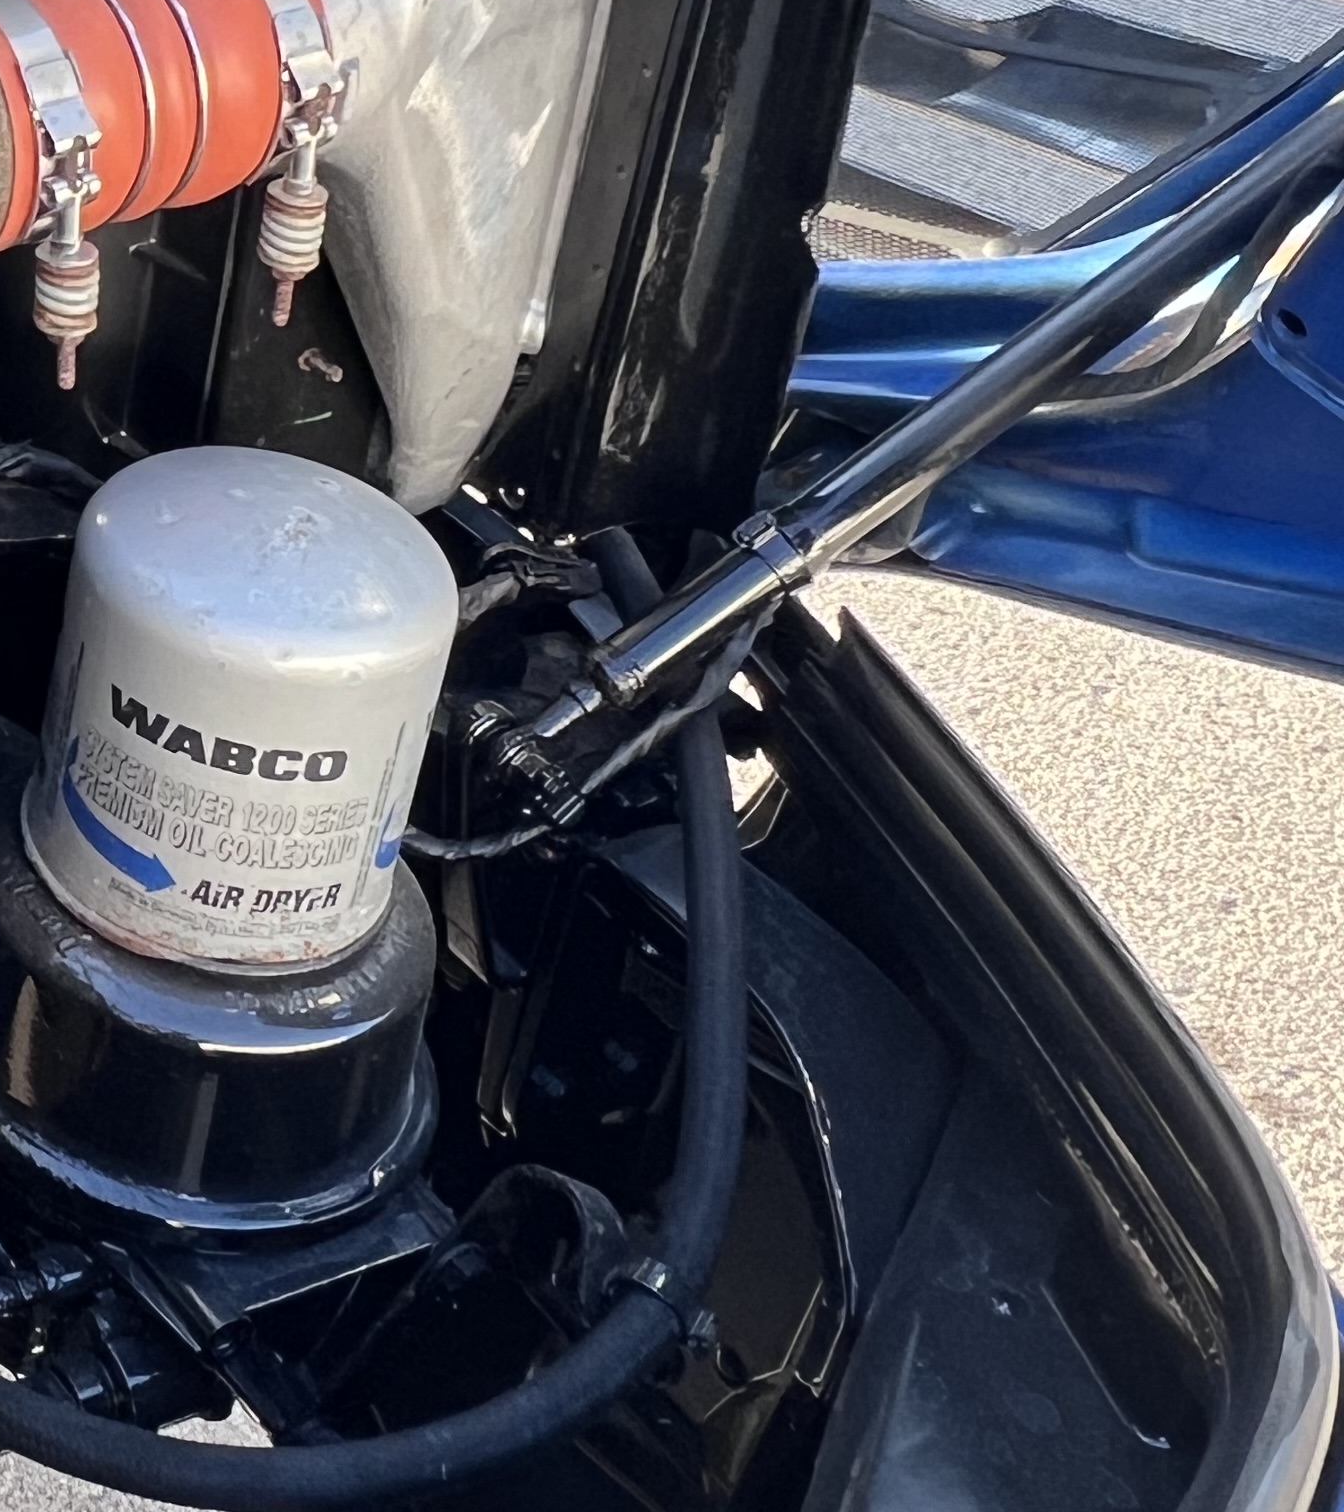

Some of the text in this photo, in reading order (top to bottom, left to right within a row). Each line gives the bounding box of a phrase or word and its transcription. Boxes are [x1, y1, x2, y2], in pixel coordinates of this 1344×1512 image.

[111, 683, 348, 782] WABCO
[158, 776, 234, 827] SAVER
[242, 800, 297, 836] 1200
[299, 797, 369, 836] SERIES
[189, 879, 245, 910] AIR
